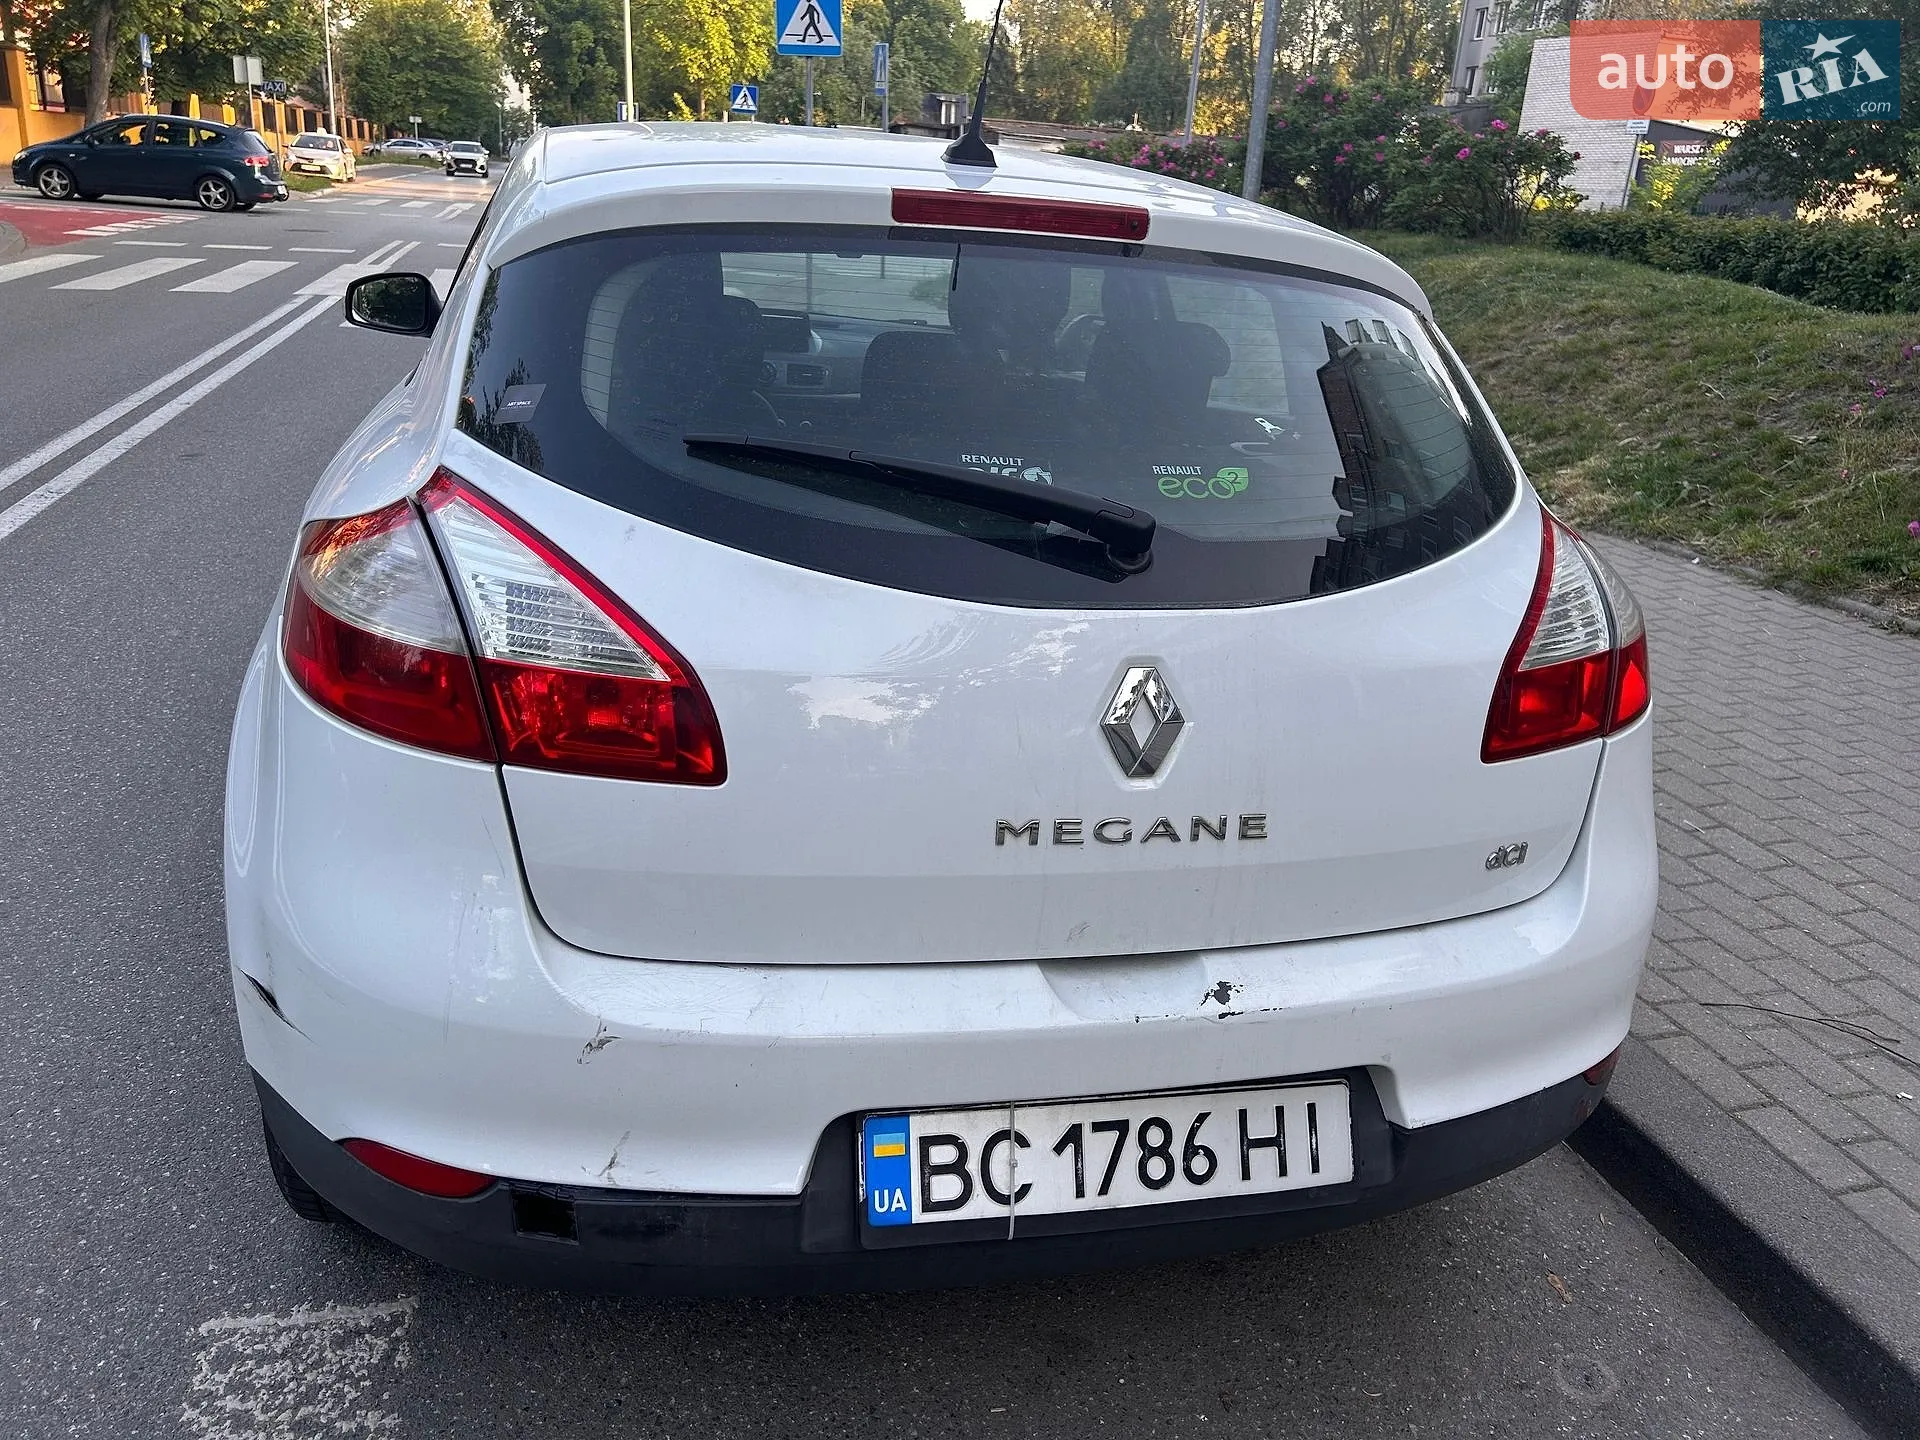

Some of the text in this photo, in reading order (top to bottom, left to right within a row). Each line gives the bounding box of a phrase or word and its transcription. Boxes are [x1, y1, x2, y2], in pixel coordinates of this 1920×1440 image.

[263, 82, 284, 92] TAXI
[961, 454, 1024, 466] RENAULT
[1152, 465, 1202, 475] RENAULT
[995, 813, 1268, 846] MEGANE
[918, 1101, 1321, 1213] BC 1786 HI
[874, 1187, 908, 1213] UA
